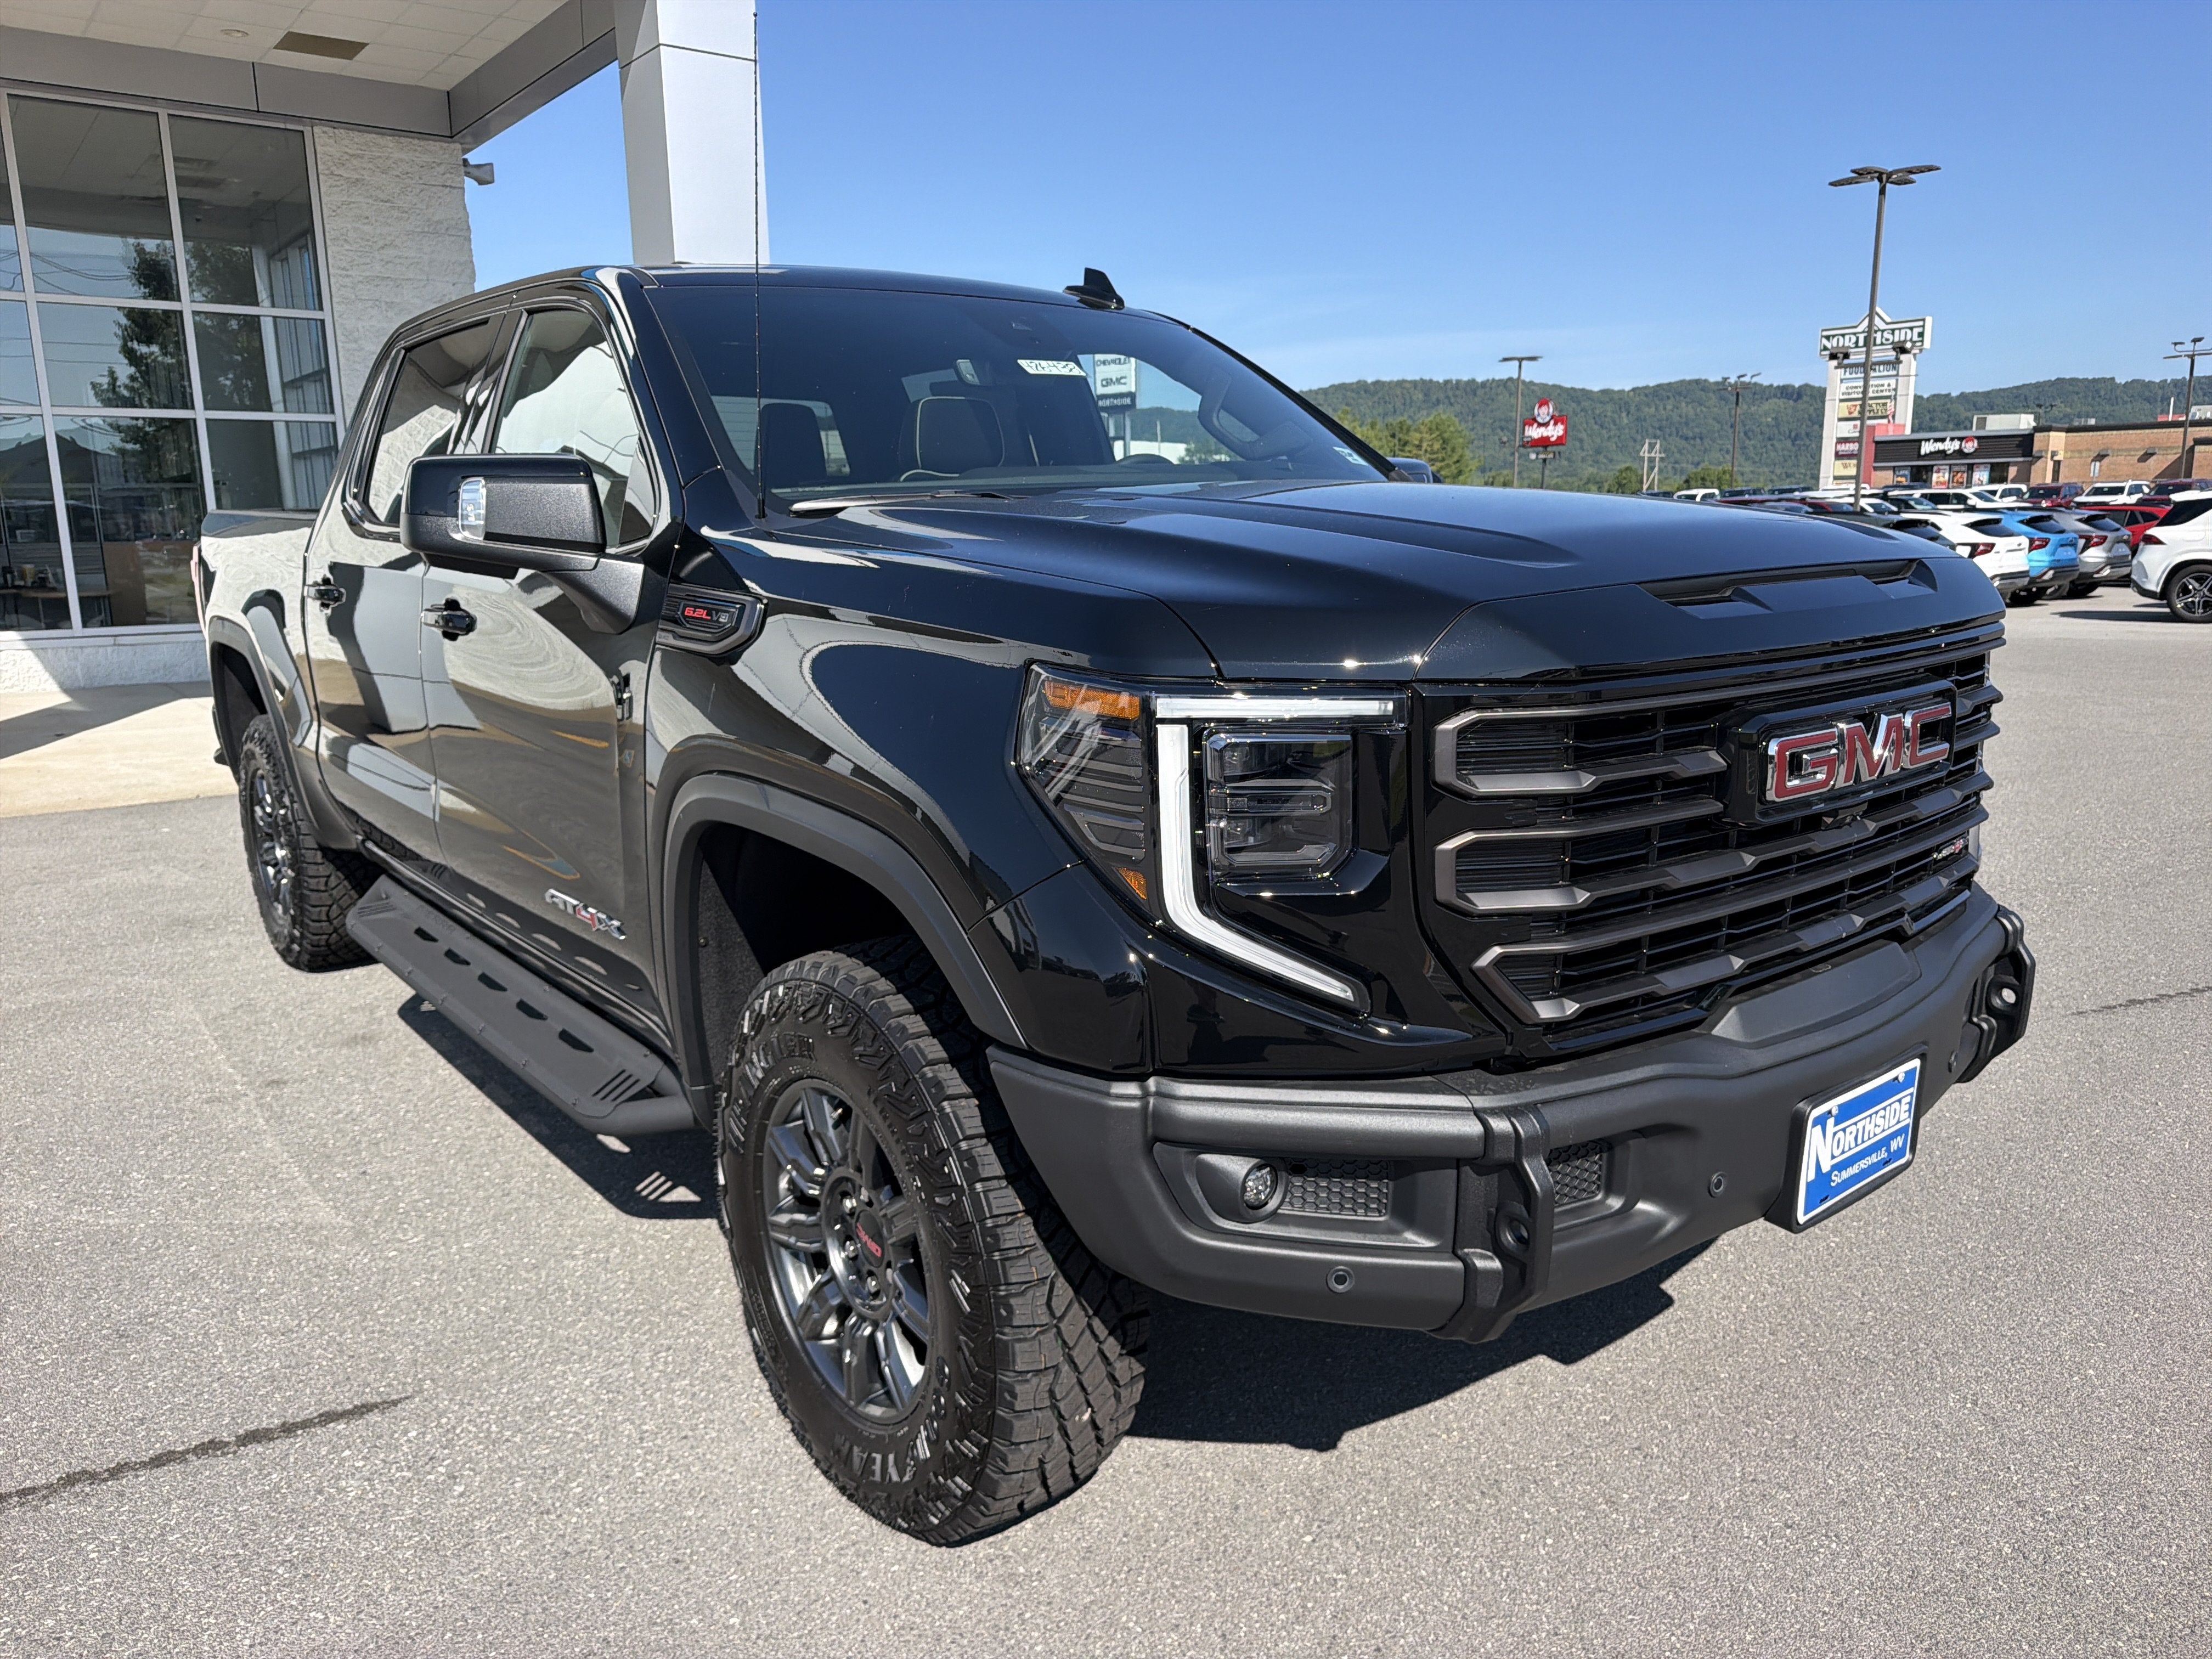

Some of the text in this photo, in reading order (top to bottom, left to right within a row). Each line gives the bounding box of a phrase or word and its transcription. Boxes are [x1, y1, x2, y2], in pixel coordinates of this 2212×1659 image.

[1101, 376, 1127, 387] GMC
[1525, 420, 1564, 442] Wendy's
[1920, 436, 1961, 455] Wendy's
[684, 607, 712, 620] 6.2L
[1766, 702, 1951, 802] GMC
[1808, 1096, 1911, 1182] NORTHSIDE
[1830, 1133, 1905, 1187] SUMMERSVILLE, WV
[856, 1223, 882, 1257] GMC
